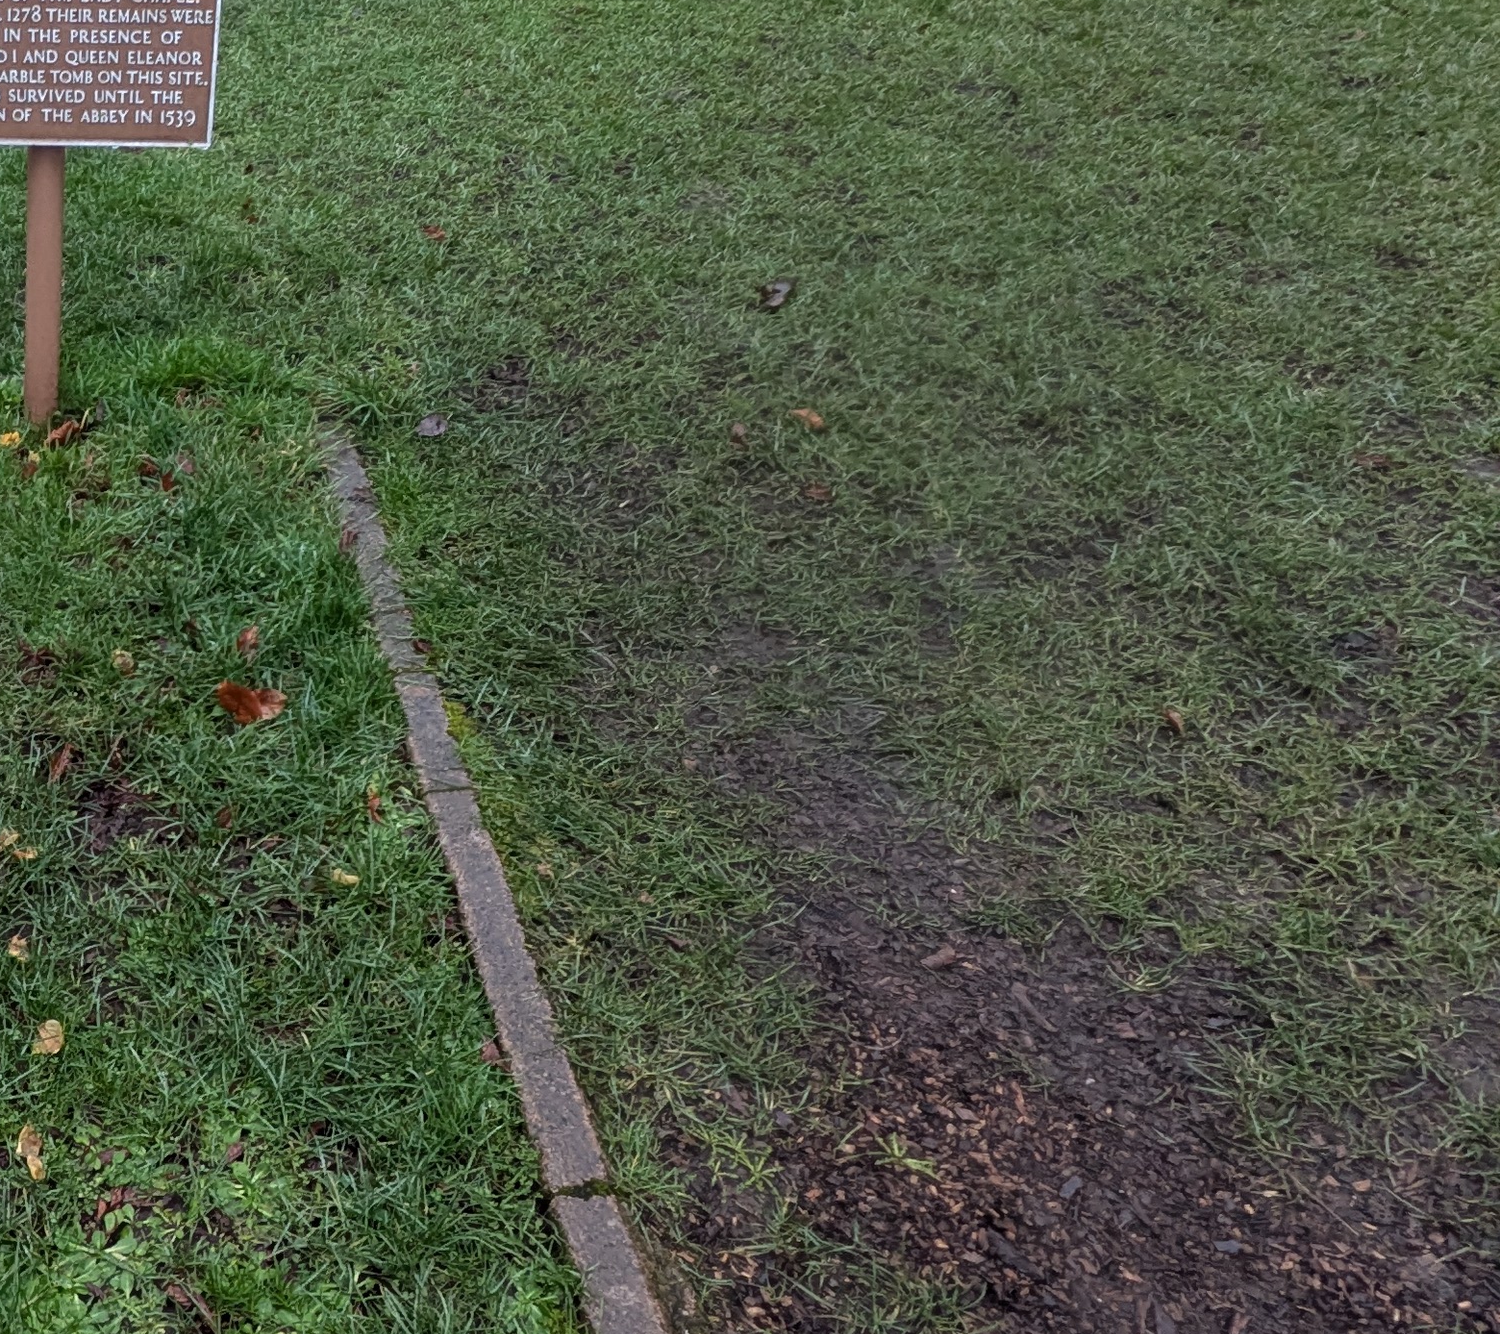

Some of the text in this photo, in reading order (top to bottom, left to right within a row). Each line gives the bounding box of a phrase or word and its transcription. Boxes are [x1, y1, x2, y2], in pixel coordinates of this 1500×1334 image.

[7, 4, 41, 23] 1278
[45, 8, 94, 23] THEIR
[98, 8, 167, 23] REMAINS
[170, 9, 213, 24] WERE
[4, 27, 21, 42] IN
[27, 28, 61, 43] THE
[70, 29, 152, 44] PRESENCE
[161, 30, 183, 44] OF
[12, 49, 17, 63] I
[23, 49, 58, 64] AND
[65, 49, 119, 66] QUEEN
[128, 50, 203, 65] ELEANOR
[49, 70, 93, 84] TOMB
[97, 70, 122, 84] ON
[126, 70, 163, 84] THIS
[168, 71, 208, 86] SITE.
[8, 88, 85, 103] SURVIVED
[94, 89, 145, 104] UNTIL
[150, 90, 183, 104] THE
[12, 108, 32, 122] OF
[41, 108, 73, 123] THE
[80, 109, 129, 123] ABBEY
[135, 109, 153, 123] IN
[160, 109, 196, 128] 1539
